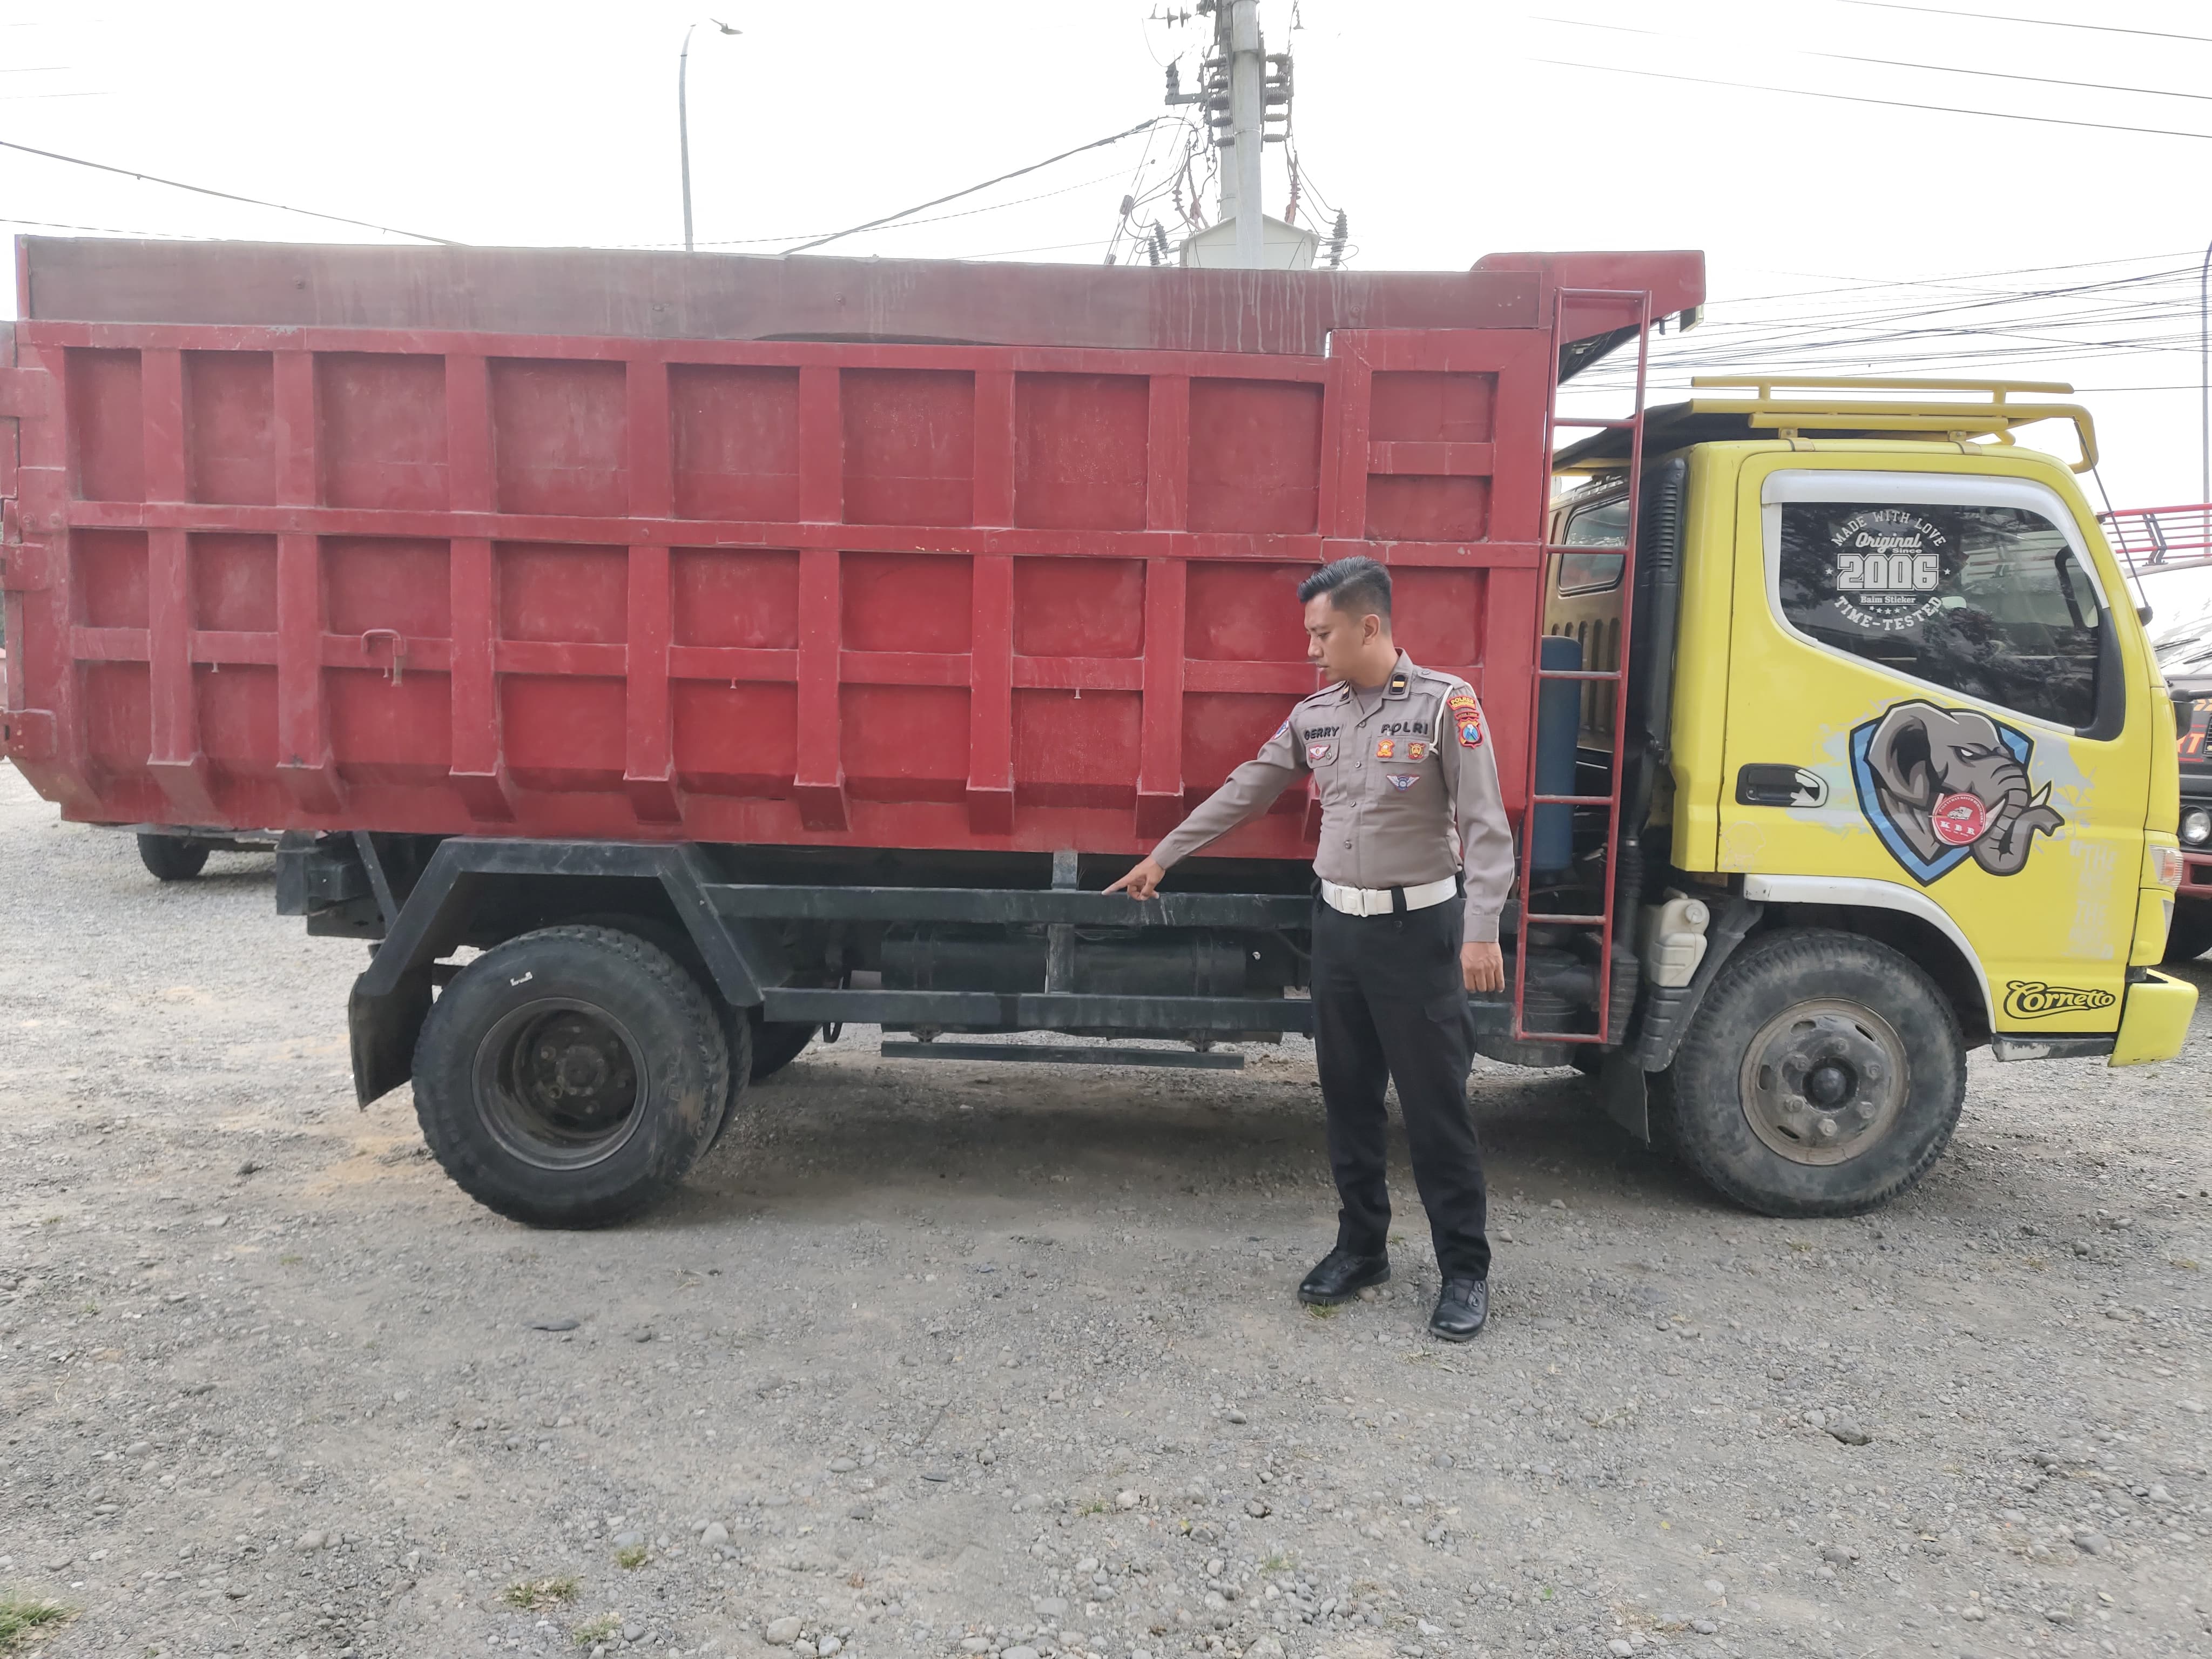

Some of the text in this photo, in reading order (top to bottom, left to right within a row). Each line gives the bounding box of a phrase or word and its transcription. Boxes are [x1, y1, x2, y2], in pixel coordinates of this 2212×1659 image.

[1831, 510, 1946, 547] MADE WITH LOVE
[1855, 532, 1921, 554] Original
[1837, 554, 1939, 591] 2006
[1834, 596, 1943, 631] TIME-TESTED
[1860, 596, 1916, 604] Baim Sticker
[1381, 722, 1428, 736] POLRI
[2003, 980, 2116, 1019] Cornetto
